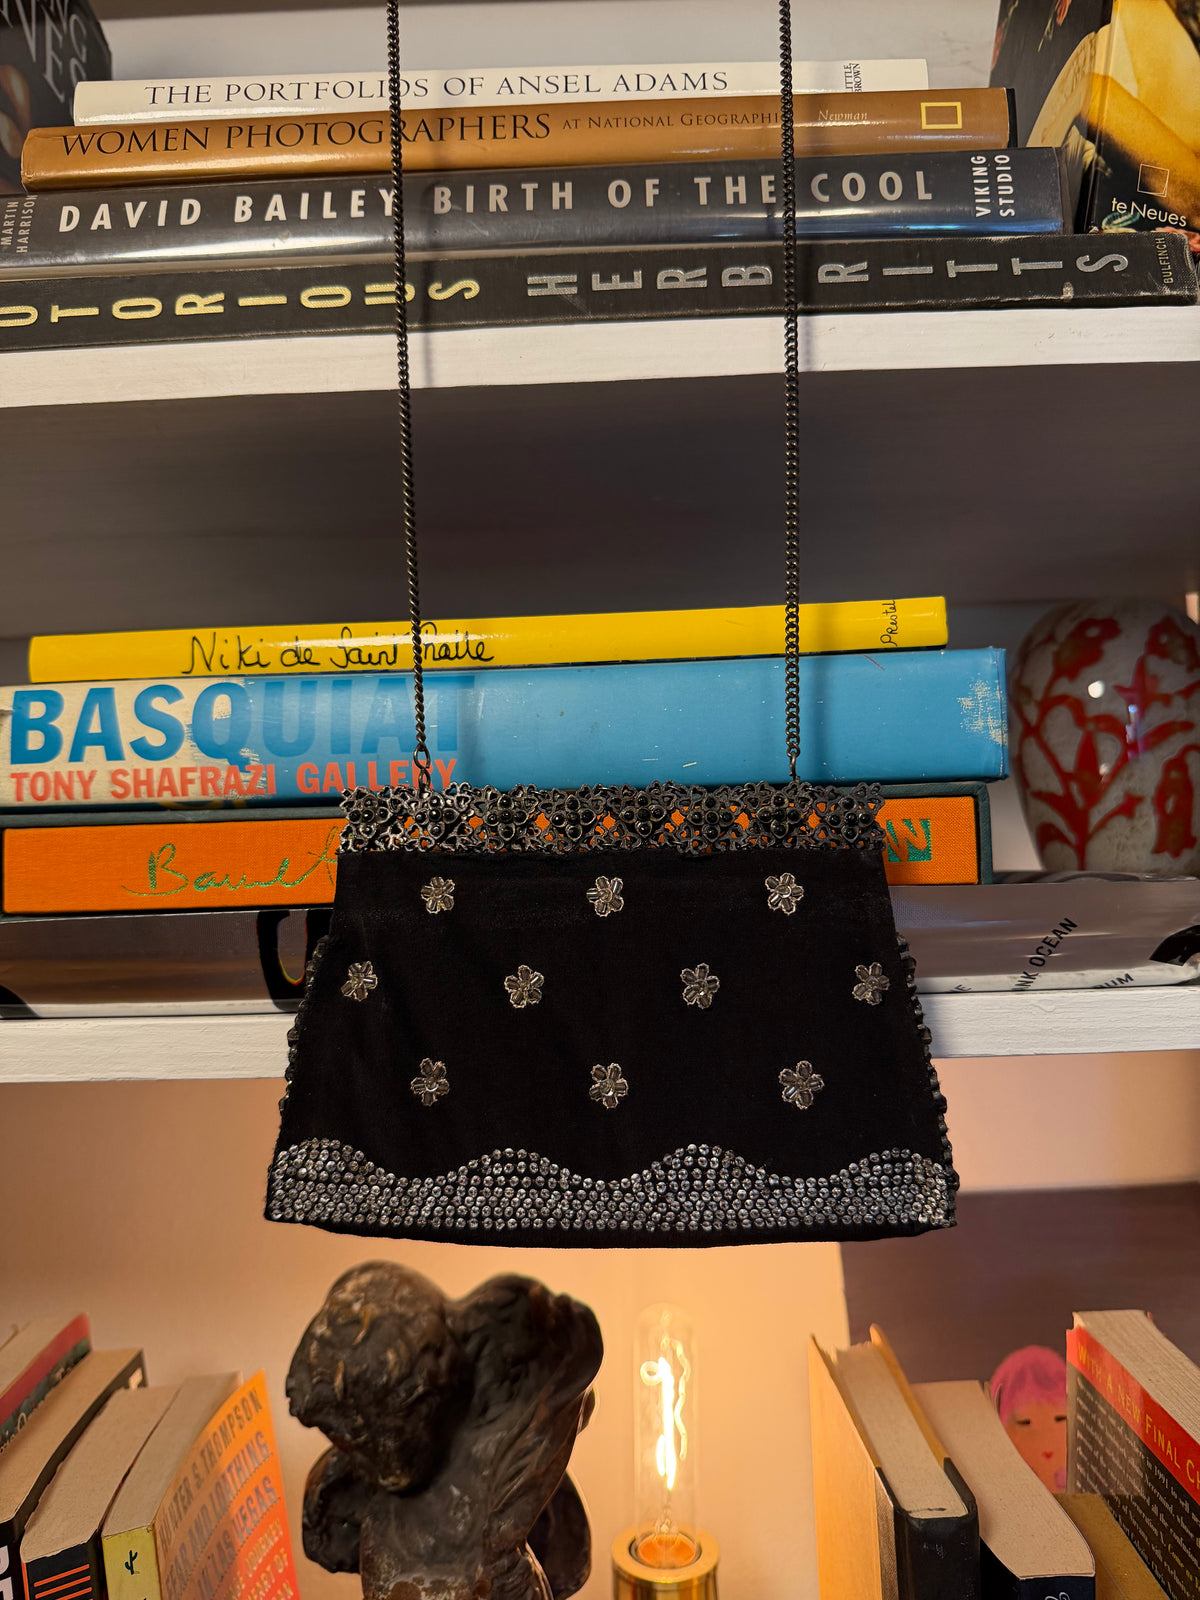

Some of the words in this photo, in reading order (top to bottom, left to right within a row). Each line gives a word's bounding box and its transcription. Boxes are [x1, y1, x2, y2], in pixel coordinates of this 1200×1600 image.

[145, 83, 212, 105] THE
[443, 76, 485, 96] OF
[497, 74, 602, 95] ANSEL
[612, 71, 729, 92] ADAMS
[62, 126, 212, 156] WOMEN
[226, 112, 551, 149] PHOTOGRAPHERS
[562, 118, 580, 130] AT
[588, 114, 674, 129] NATIONAL
[680, 111, 779, 127] GEOGRAPHI
[818, 109, 868, 121] Newman
[59, 198, 201, 233] DAVID
[234, 188, 399, 224] BAILEY
[433, 181, 574, 215] BIRTH
[607, 178, 660, 208] OF
[693, 175, 777, 205] THE
[810, 171, 933, 203] COOL
[970, 155, 991, 217] VIKING
[994, 154, 1015, 217] STUDIO
[1, 201, 19, 246] MARTIN
[16, 194, 38, 253] HARRISON
[526, 264, 773, 297] HERB
[817, 253, 1129, 285] RITTS
[1155, 237, 1174, 284] BULFINCH
[181, 631, 271, 675] Niki
[280, 635, 321, 667] de
[10, 675, 475, 765] BASQUIAT
[10, 769, 97, 802] TONY
[110, 764, 277, 799] SHAFRAZI
[296, 758, 458, 794] GALLERY
[1029, 917, 1078, 967] OCEAN
[200, 1388, 262, 1475] THOMPSON
[1106, 1373, 1113, 1394] A
[1118, 1384, 1140, 1424] NEW
[1145, 1413, 1180, 1469] FINAL
[209, 1431, 271, 1521] LOATHING
[1154, 1465, 1168, 1489] 1991
[231, 1475, 279, 1545] VEGAS
